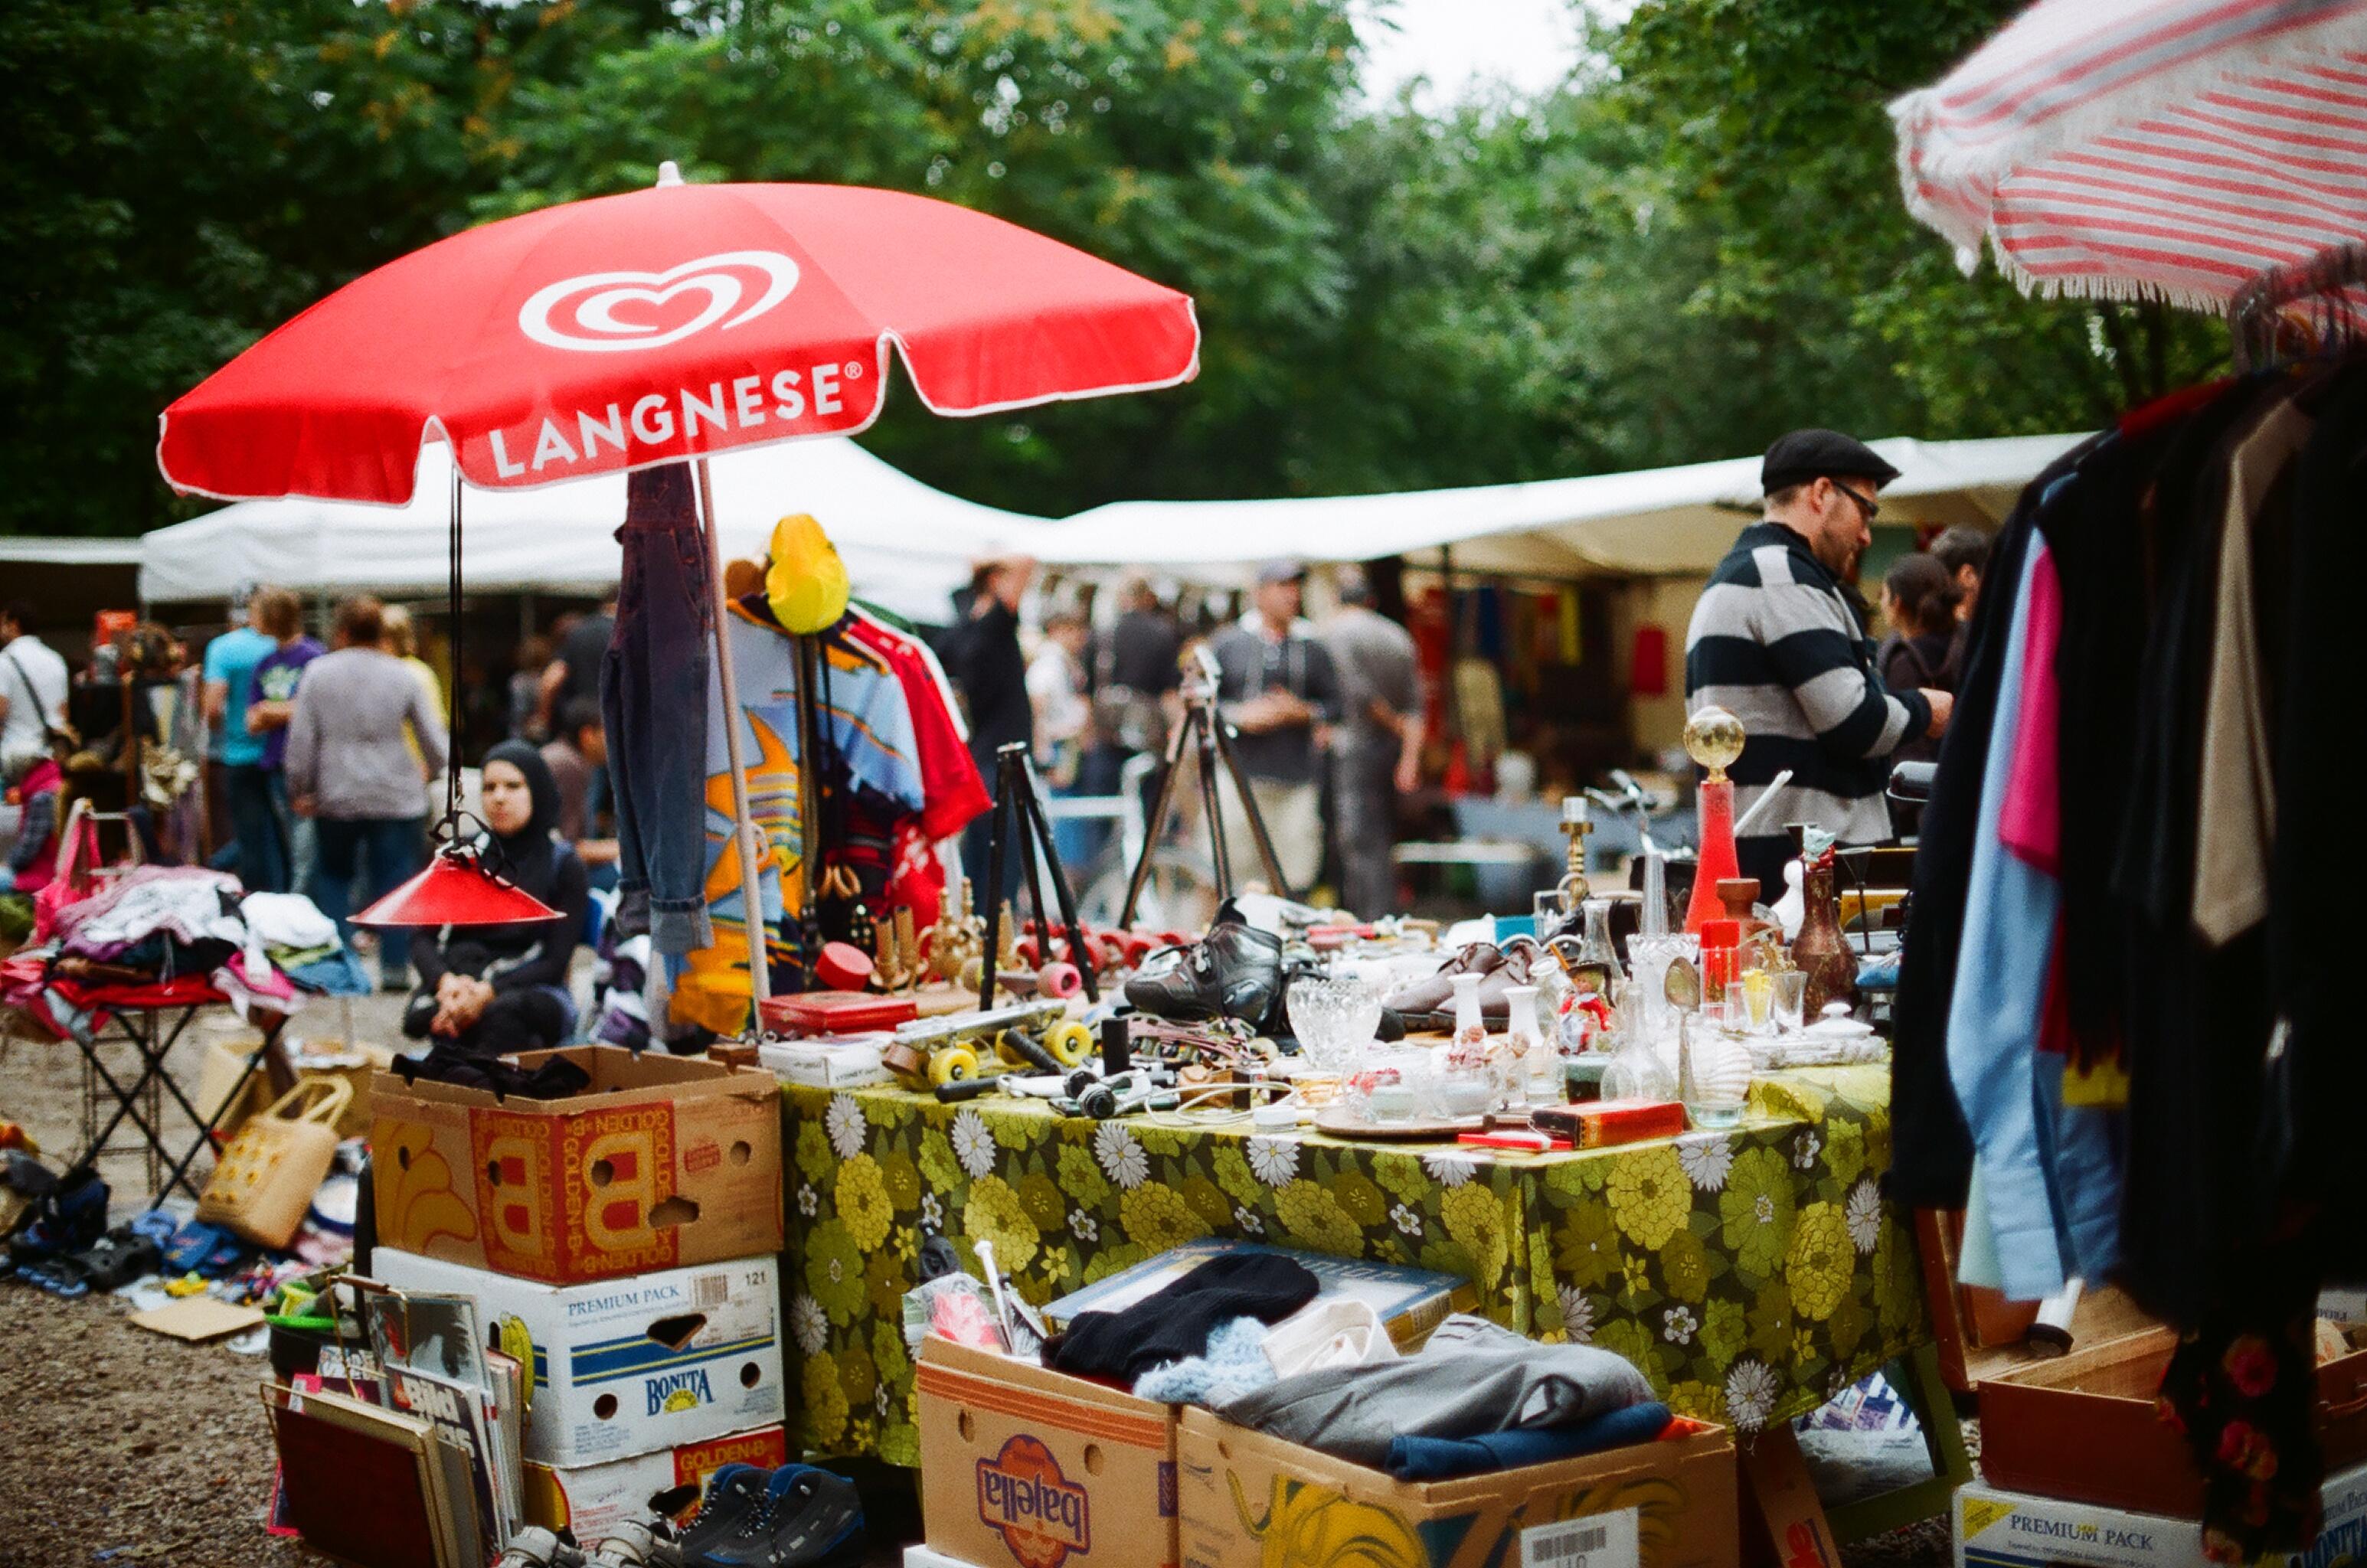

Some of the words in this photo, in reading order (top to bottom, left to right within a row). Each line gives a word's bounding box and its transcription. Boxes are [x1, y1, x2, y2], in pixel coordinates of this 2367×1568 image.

[581, 1129, 657, 1253] B
[567, 1292, 639, 1317] PREMIUM
[643, 1284, 680, 1304] PACK
[745, 1271, 767, 1286] 121
[401, 1376, 460, 1425] Bild
[645, 1368, 716, 1416] BONITA
[983, 1469, 1083, 1543] bajella
[2009, 1514, 2099, 1542] PREMIUM
[2104, 1528, 2155, 1551] PACK
